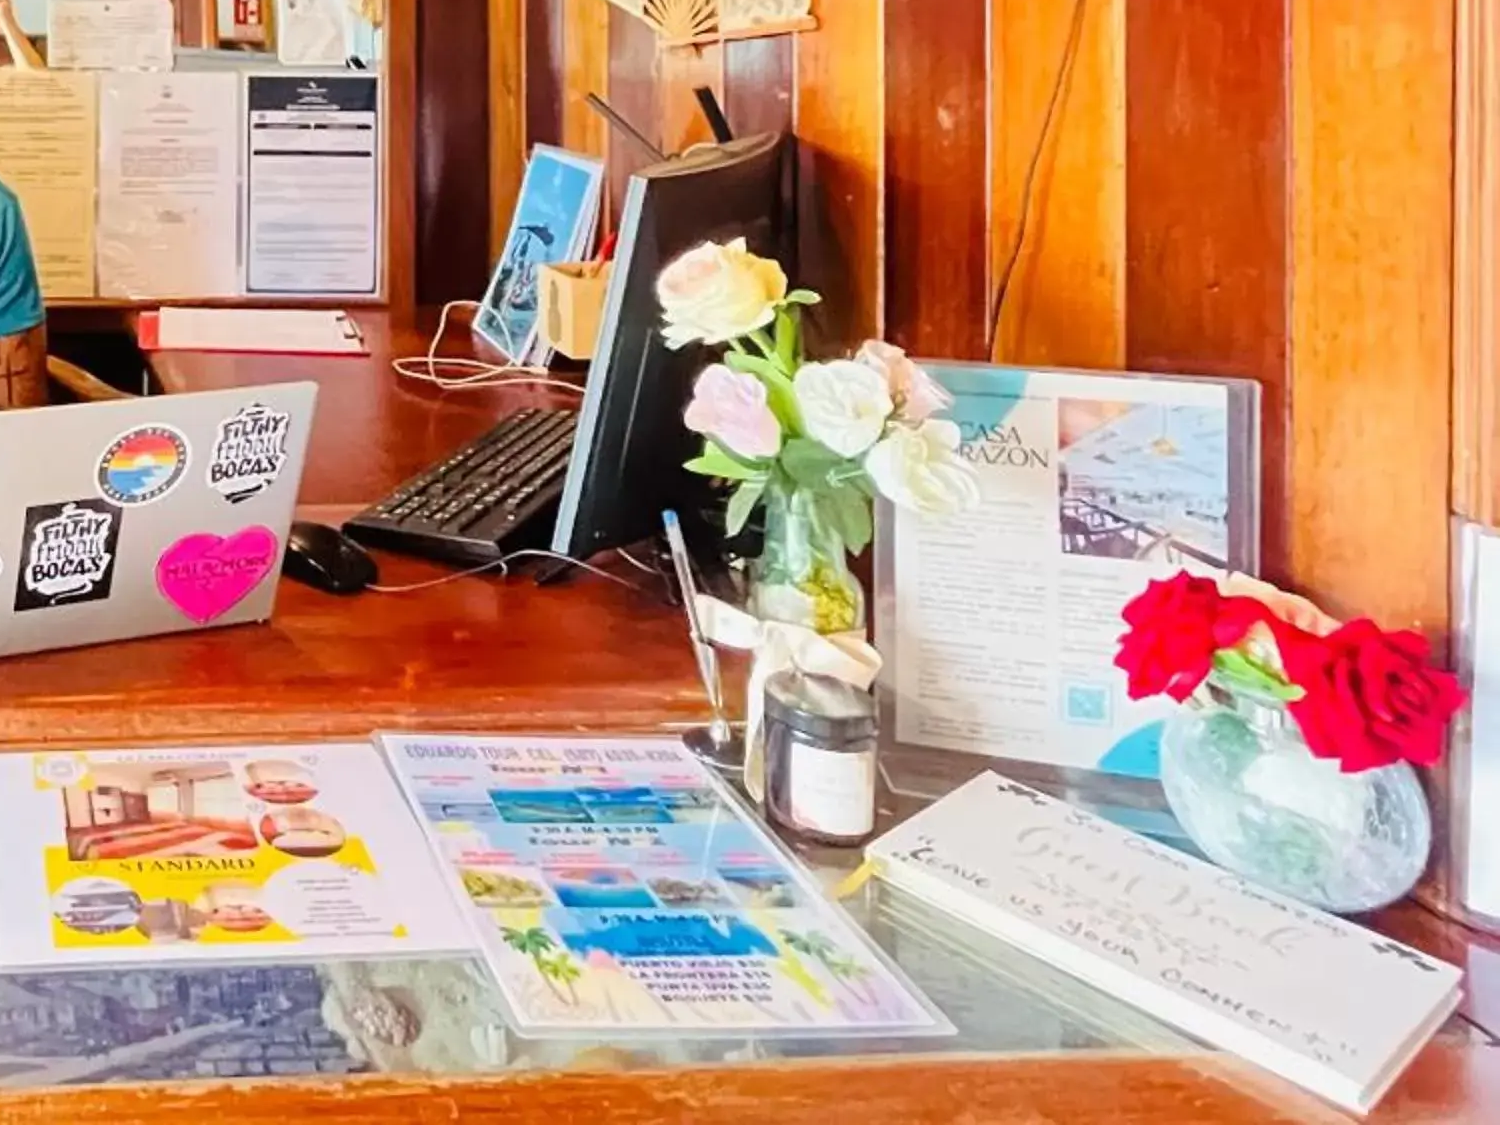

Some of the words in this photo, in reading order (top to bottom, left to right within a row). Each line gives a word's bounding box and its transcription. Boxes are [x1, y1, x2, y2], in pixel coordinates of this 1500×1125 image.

[211, 455, 280, 483] BOCAS
[32, 556, 104, 583] BOCAS
[118, 858, 256, 873] STANDARD
